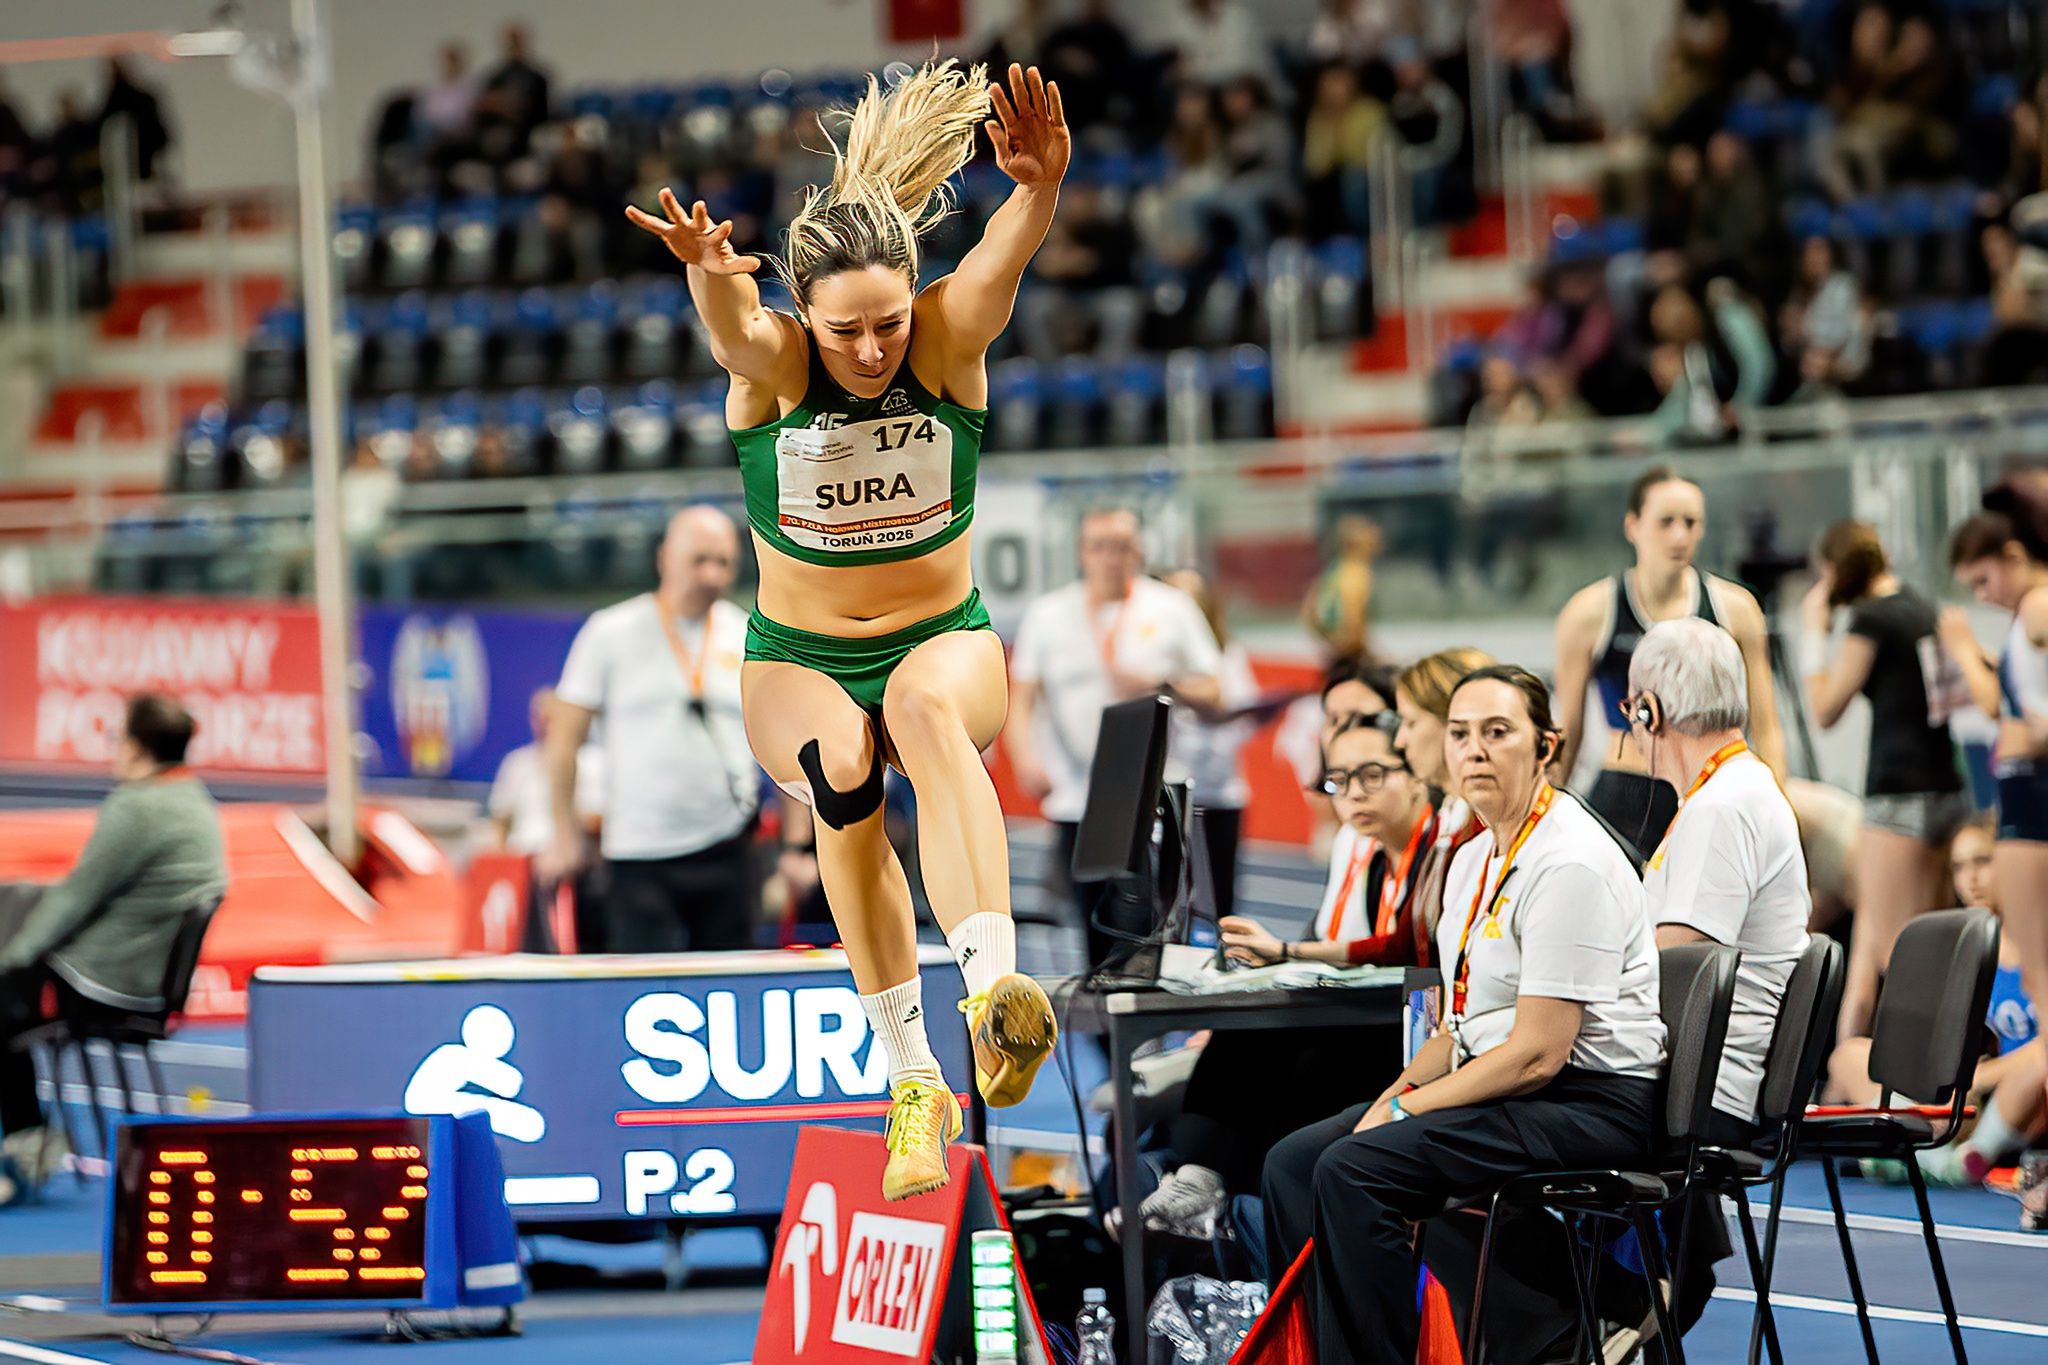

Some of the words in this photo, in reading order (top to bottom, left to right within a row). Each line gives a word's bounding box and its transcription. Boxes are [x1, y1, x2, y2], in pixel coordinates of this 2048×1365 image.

[872, 418, 936, 452] 174
[815, 472, 916, 510] SURA
[876, 529, 914, 544] 2026
[623, 1147, 737, 1216] P.2
[847, 1235, 934, 1333] ORLEN
